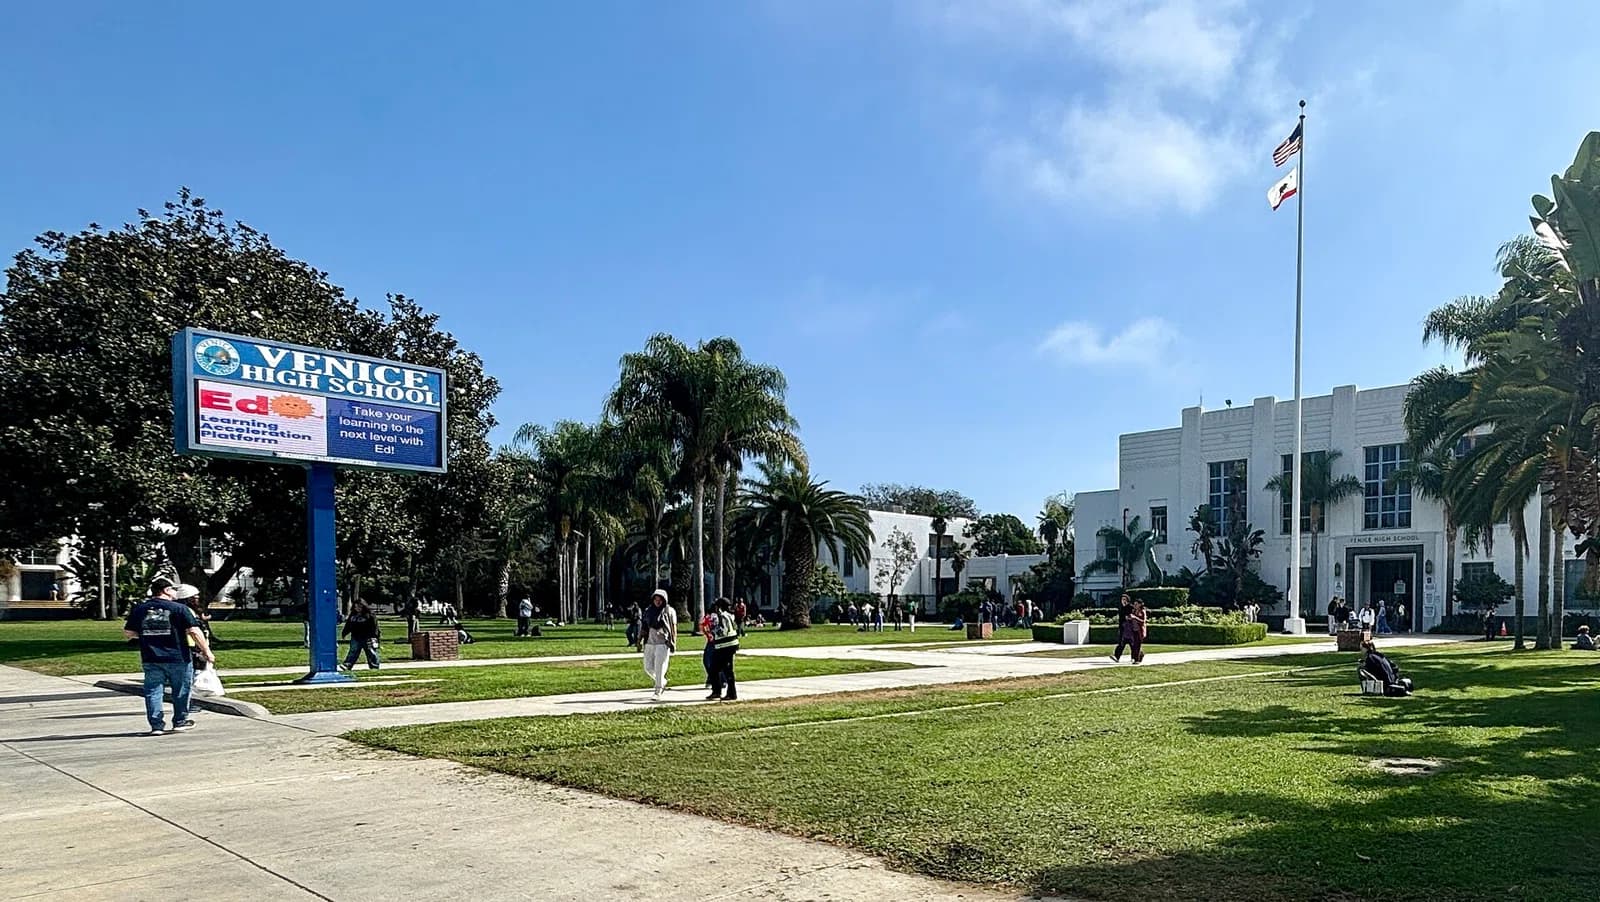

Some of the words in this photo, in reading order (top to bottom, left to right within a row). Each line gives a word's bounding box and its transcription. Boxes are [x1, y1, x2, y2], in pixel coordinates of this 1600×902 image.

[255, 345, 429, 391] VENICE
[240, 364, 320, 390] HIGH
[328, 377, 440, 407] SCHOOL
[200, 389, 269, 415] Ed
[200, 414, 278, 431] Learning
[352, 406, 382, 418] Take
[386, 410, 412, 422] your
[200, 423, 312, 441] Acceleration
[339, 416, 388, 432] learning
[391, 423, 402, 432] to
[406, 424, 424, 435] the
[200, 430, 279, 445] Platform
[340, 430, 367, 440] next
[370, 432, 397, 443] level
[400, 436, 424, 446] with
[374, 444, 395, 454] Ed!
